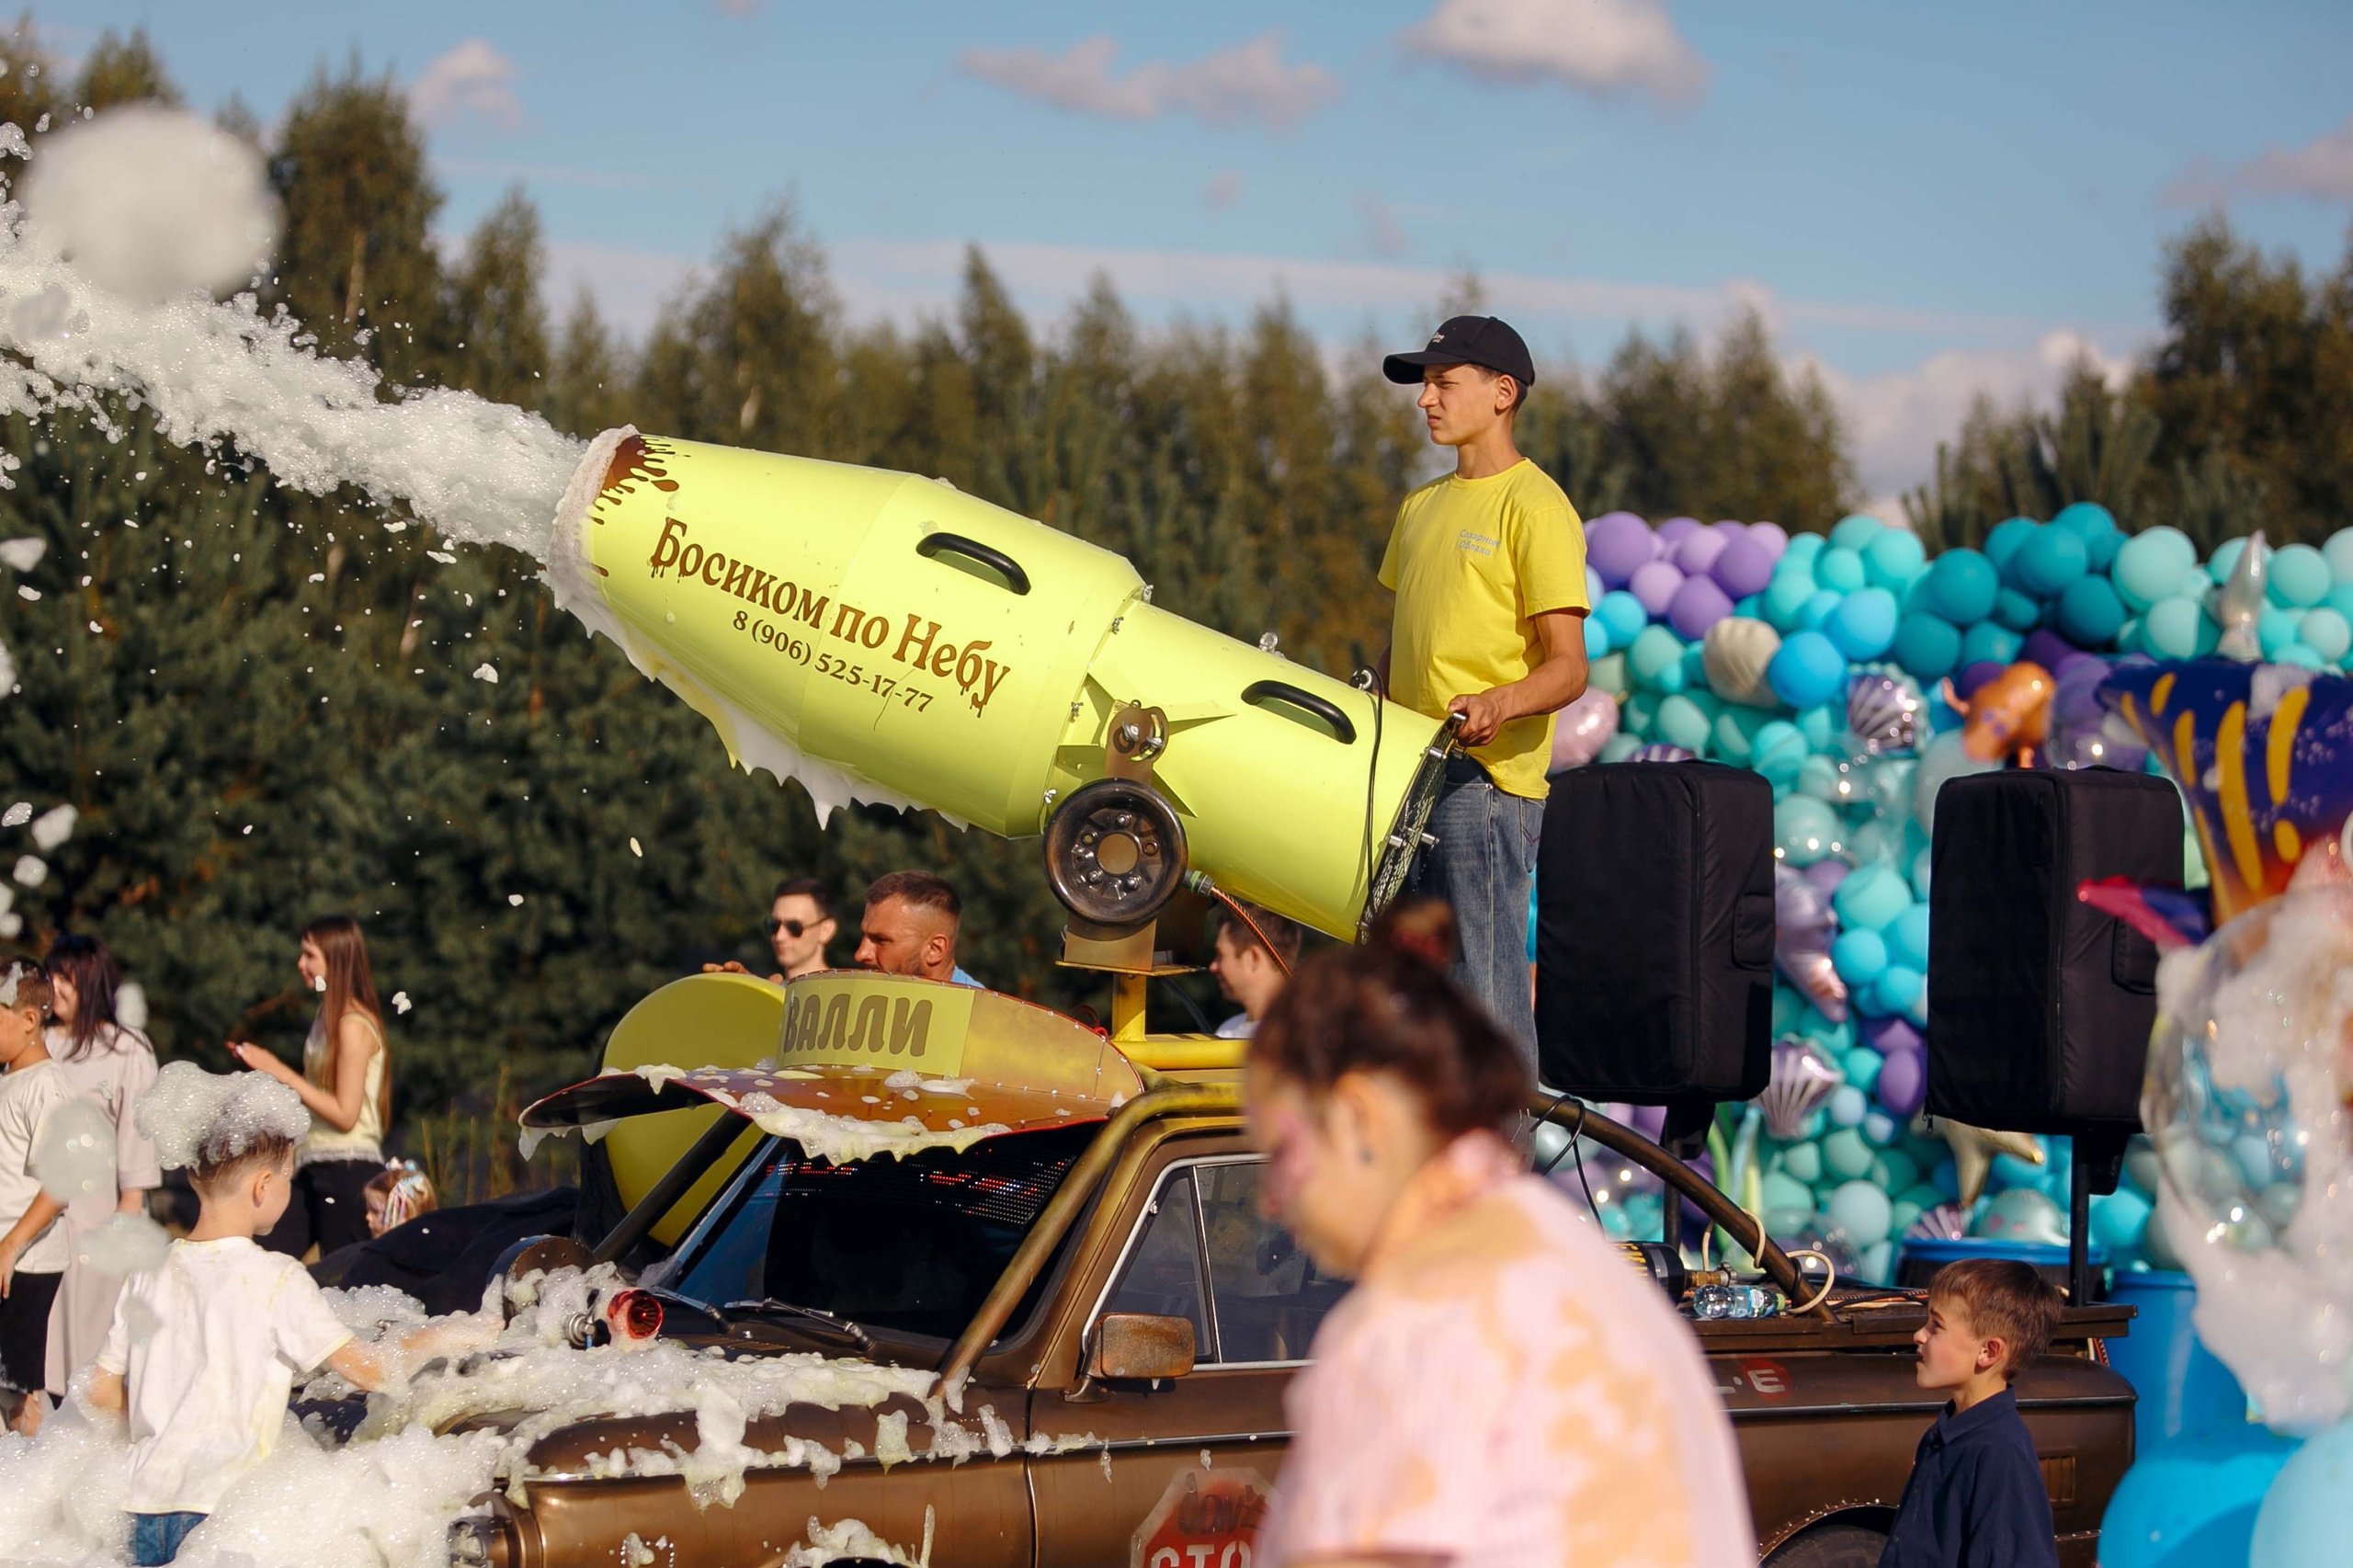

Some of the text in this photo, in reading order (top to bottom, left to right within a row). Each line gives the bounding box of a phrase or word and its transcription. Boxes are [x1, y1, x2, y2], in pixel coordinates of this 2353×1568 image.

[650, 517, 1011, 718] Босиком по Небу
[733, 610, 935, 713] 8 (906) 525-17-77
[783, 993, 934, 1058] ВАЛЛИ
